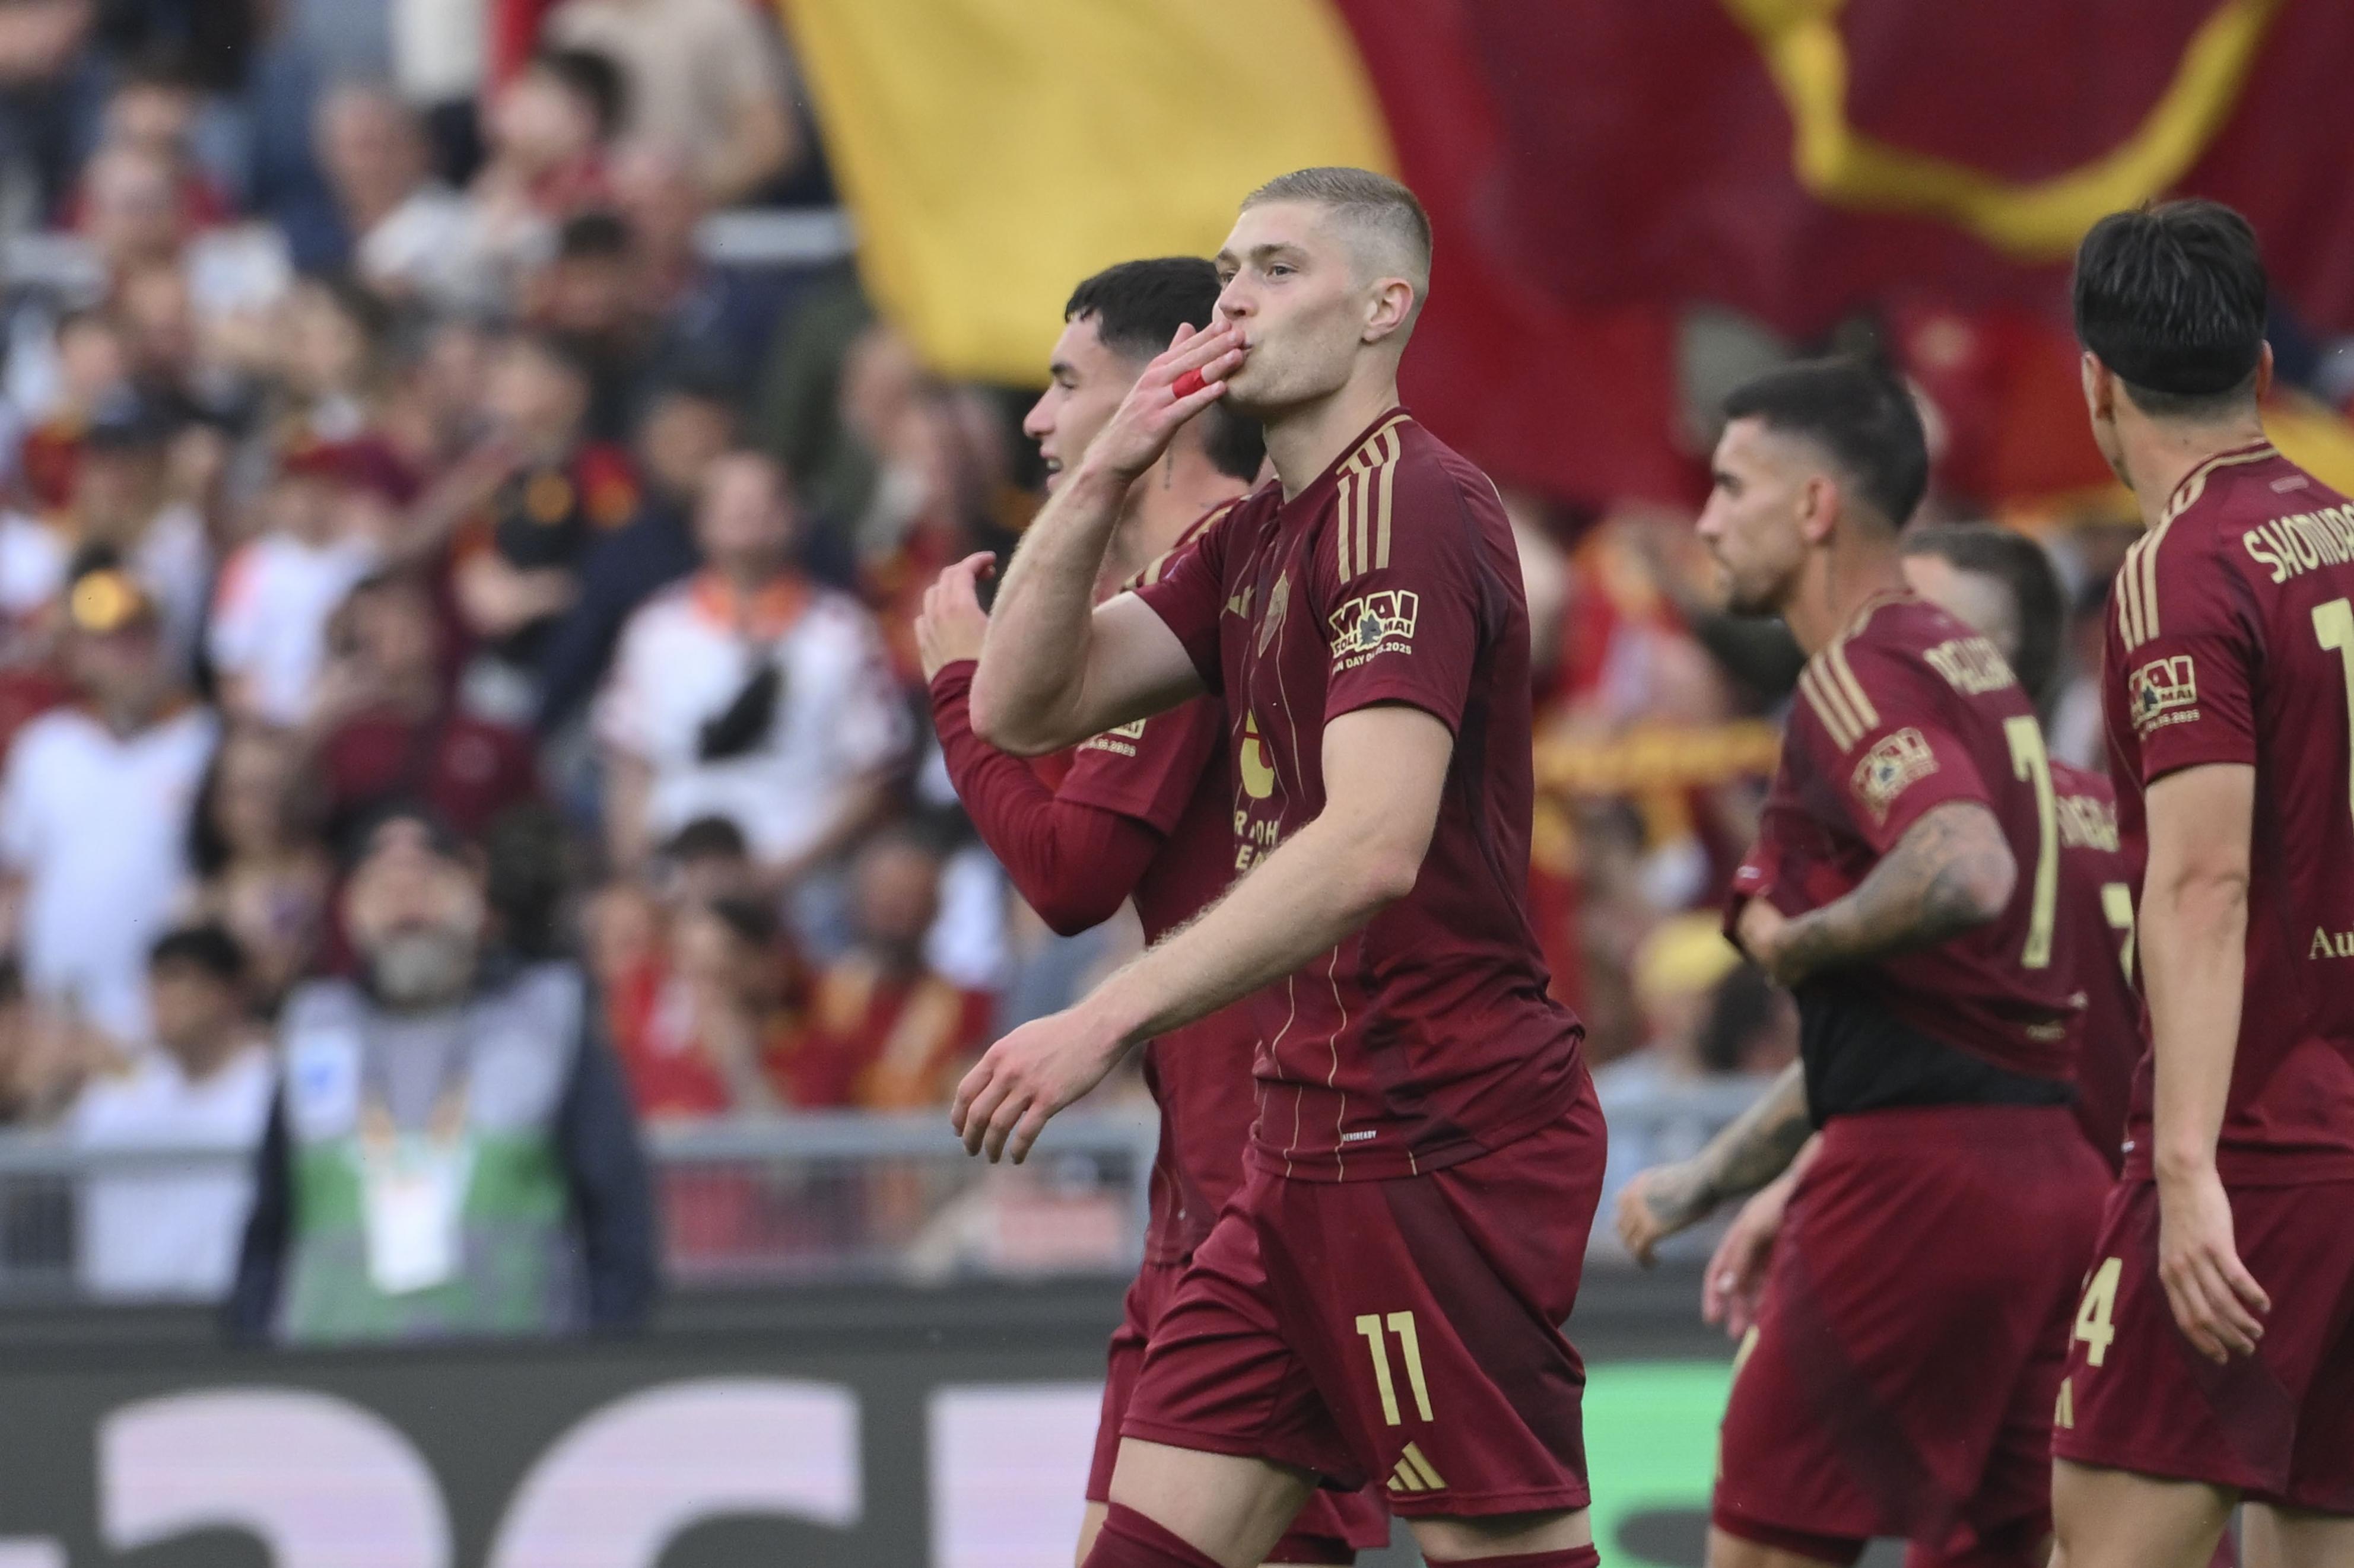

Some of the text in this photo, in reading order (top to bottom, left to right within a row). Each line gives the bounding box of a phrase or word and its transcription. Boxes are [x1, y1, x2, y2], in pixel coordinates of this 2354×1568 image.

[1345, 655, 1365, 669] DAY
[2004, 715, 2059, 969] 7
[2307, 925, 2354, 960] Au
[1355, 1310, 1434, 1426] 11
